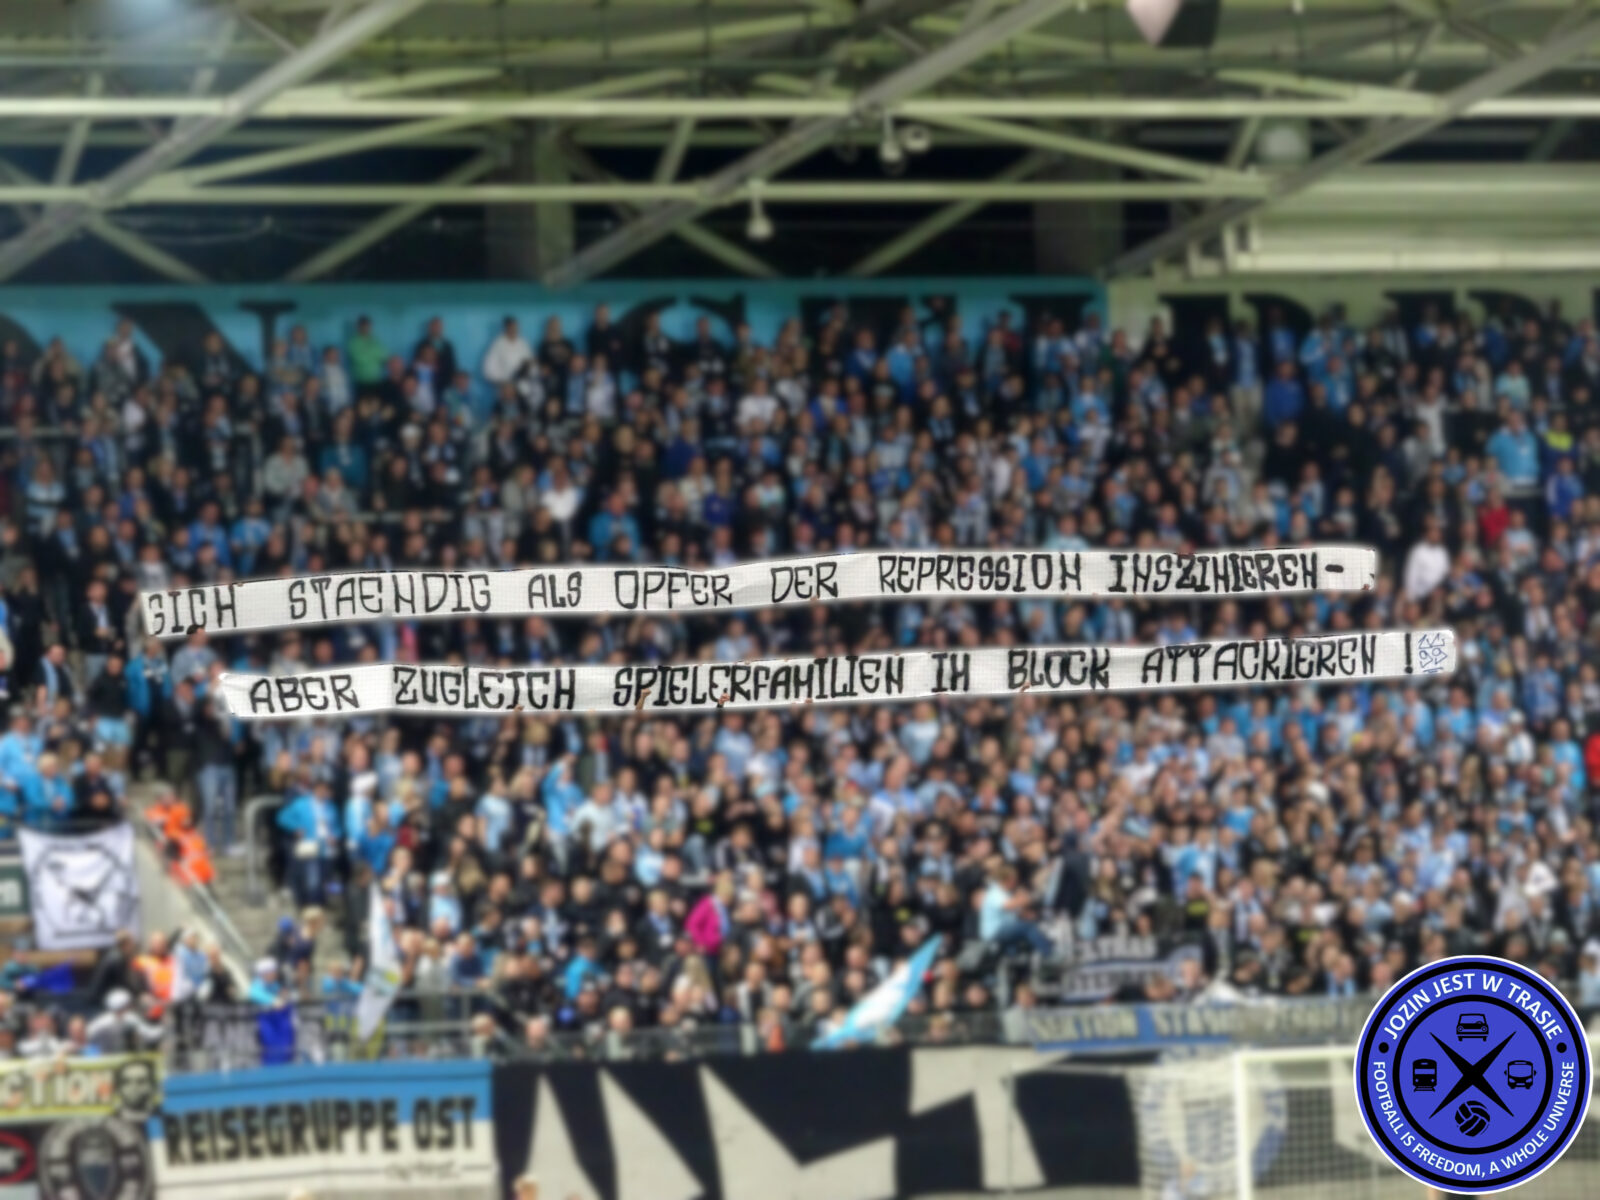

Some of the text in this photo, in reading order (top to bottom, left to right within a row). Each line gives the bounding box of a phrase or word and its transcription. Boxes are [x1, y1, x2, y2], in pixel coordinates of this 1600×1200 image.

[148, 583, 238, 635] SICH
[289, 574, 492, 620] STAENDIG
[528, 571, 582, 609] ALS
[614, 571, 733, 610] OPFER
[770, 562, 838, 603] DER
[878, 553, 1082, 594] REPRESSION
[250, 674, 359, 713] ABER
[393, 666, 576, 710] ZUGLEICH
[613, 656, 905, 707] SPIELERFAMILIEN
[1008, 649, 1110, 690] BLOCK
[1141, 634, 1377, 684] ATTACKIEREN
[163, 1097, 400, 1167] REISEGRUPPE
[412, 1095, 477, 1150] OST
